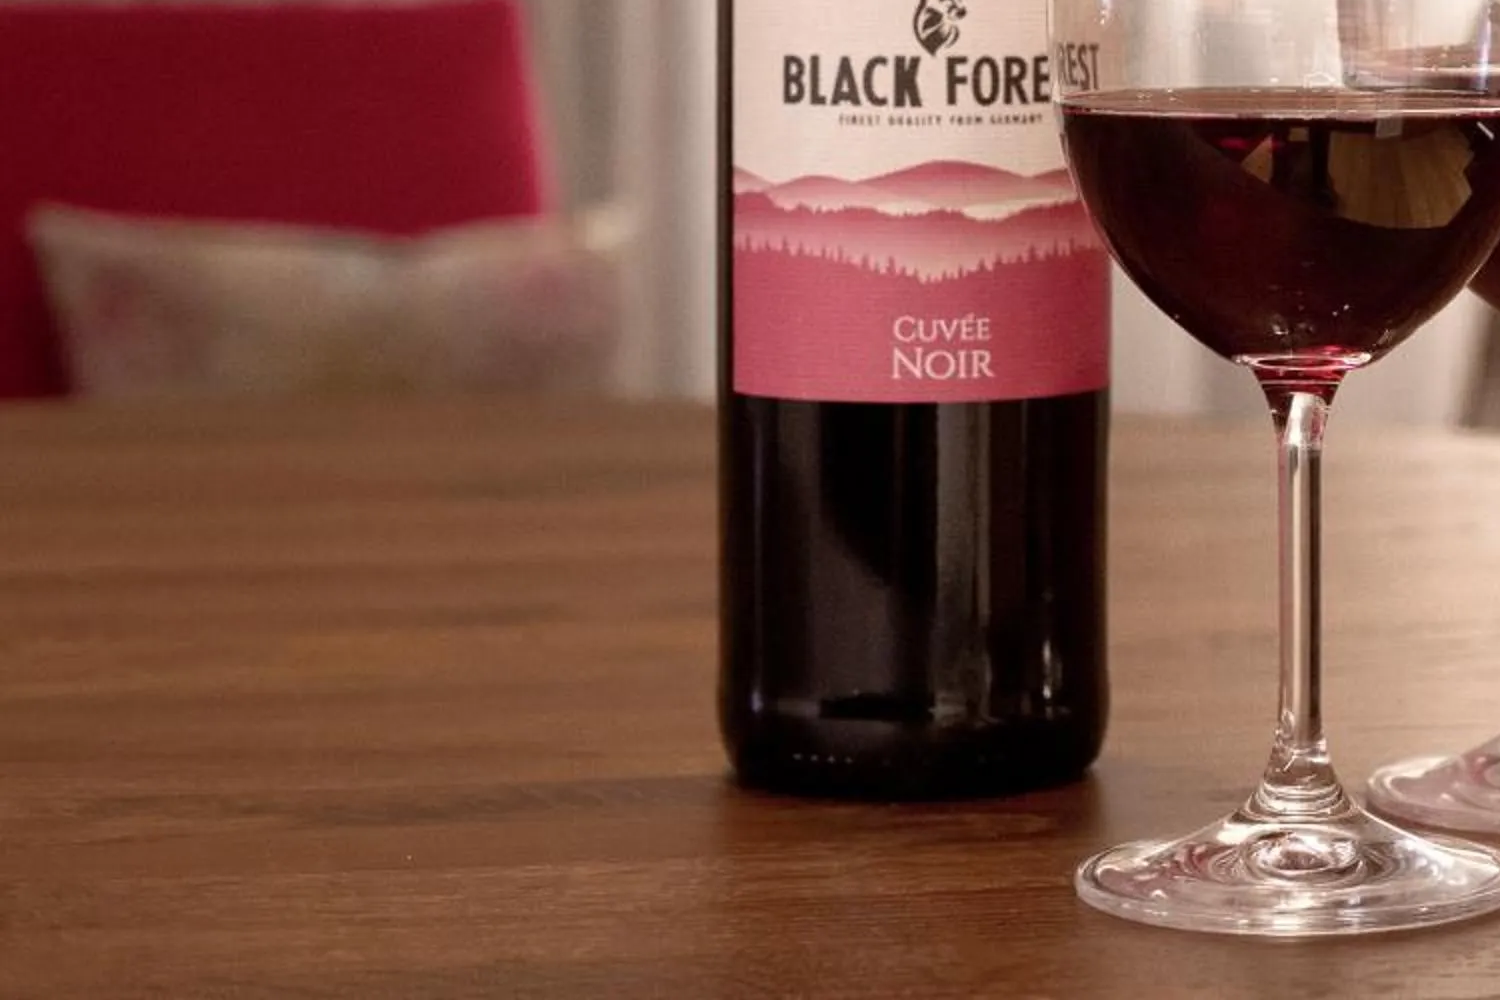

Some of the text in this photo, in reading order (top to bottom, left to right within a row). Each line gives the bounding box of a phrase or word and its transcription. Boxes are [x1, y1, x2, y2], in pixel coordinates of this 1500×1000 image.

[783, 53, 923, 107] BLACK
[950, 114, 983, 126] FROM
[891, 346, 996, 380] NOIR
